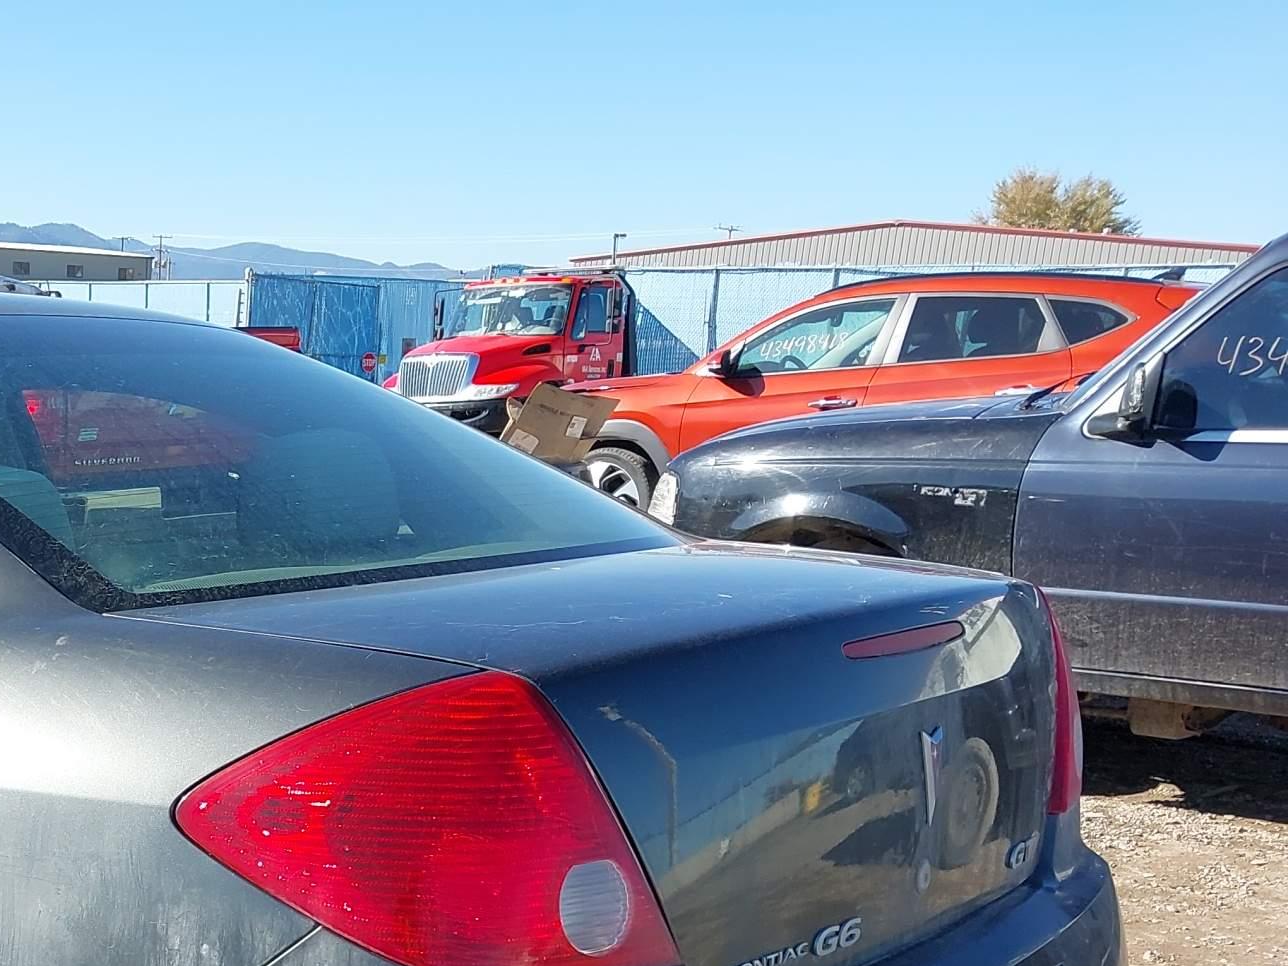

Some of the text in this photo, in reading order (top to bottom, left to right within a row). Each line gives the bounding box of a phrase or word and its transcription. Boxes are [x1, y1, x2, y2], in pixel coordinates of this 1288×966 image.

[362, 358, 377, 367] STOP
[1007, 831, 1040, 870] GT
[813, 917, 863, 957] G6
